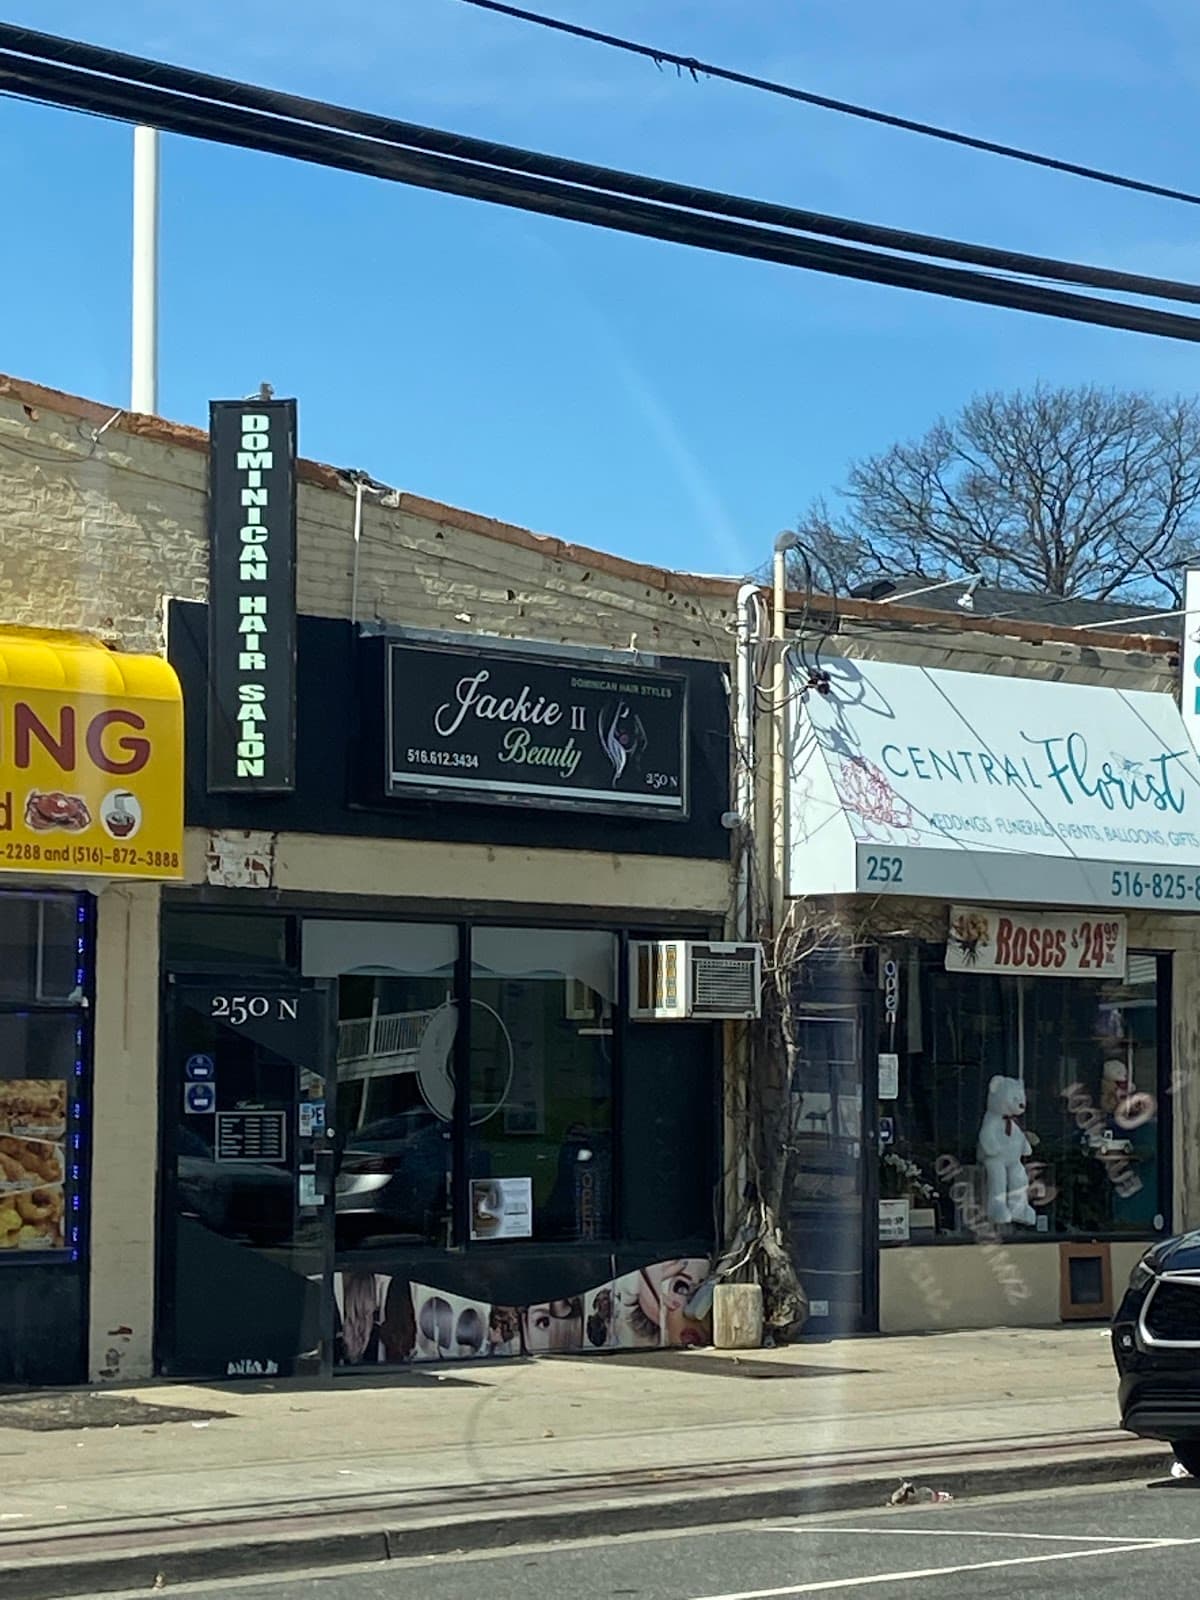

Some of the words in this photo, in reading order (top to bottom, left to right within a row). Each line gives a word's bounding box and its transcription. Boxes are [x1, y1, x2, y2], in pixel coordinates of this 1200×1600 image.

[237, 414, 273, 581] DOMINICAN
[238, 596, 268, 670] HAIR
[435, 670, 562, 737] Jackie
[570, 706, 586, 731] II
[571, 677, 618, 692] DOMINICAN
[619, 683, 639, 695] HAIR
[641, 686, 672, 699] STYLES
[236, 684, 269, 777] SALON
[407, 749, 479, 768] 516.612.3434
[498, 727, 582, 777] Beauty
[646, 773, 669, 788] 250
[670, 776, 679, 787] N
[881, 744, 1042, 789] CENTRAL
[1020, 732, 1189, 814] Florist
[44, 845, 71, 862] and
[72, 845, 179, 868] (516)-872-3888
[866, 856, 903, 882] 252
[211, 996, 270, 1024] 250
[277, 998, 298, 1020] N
